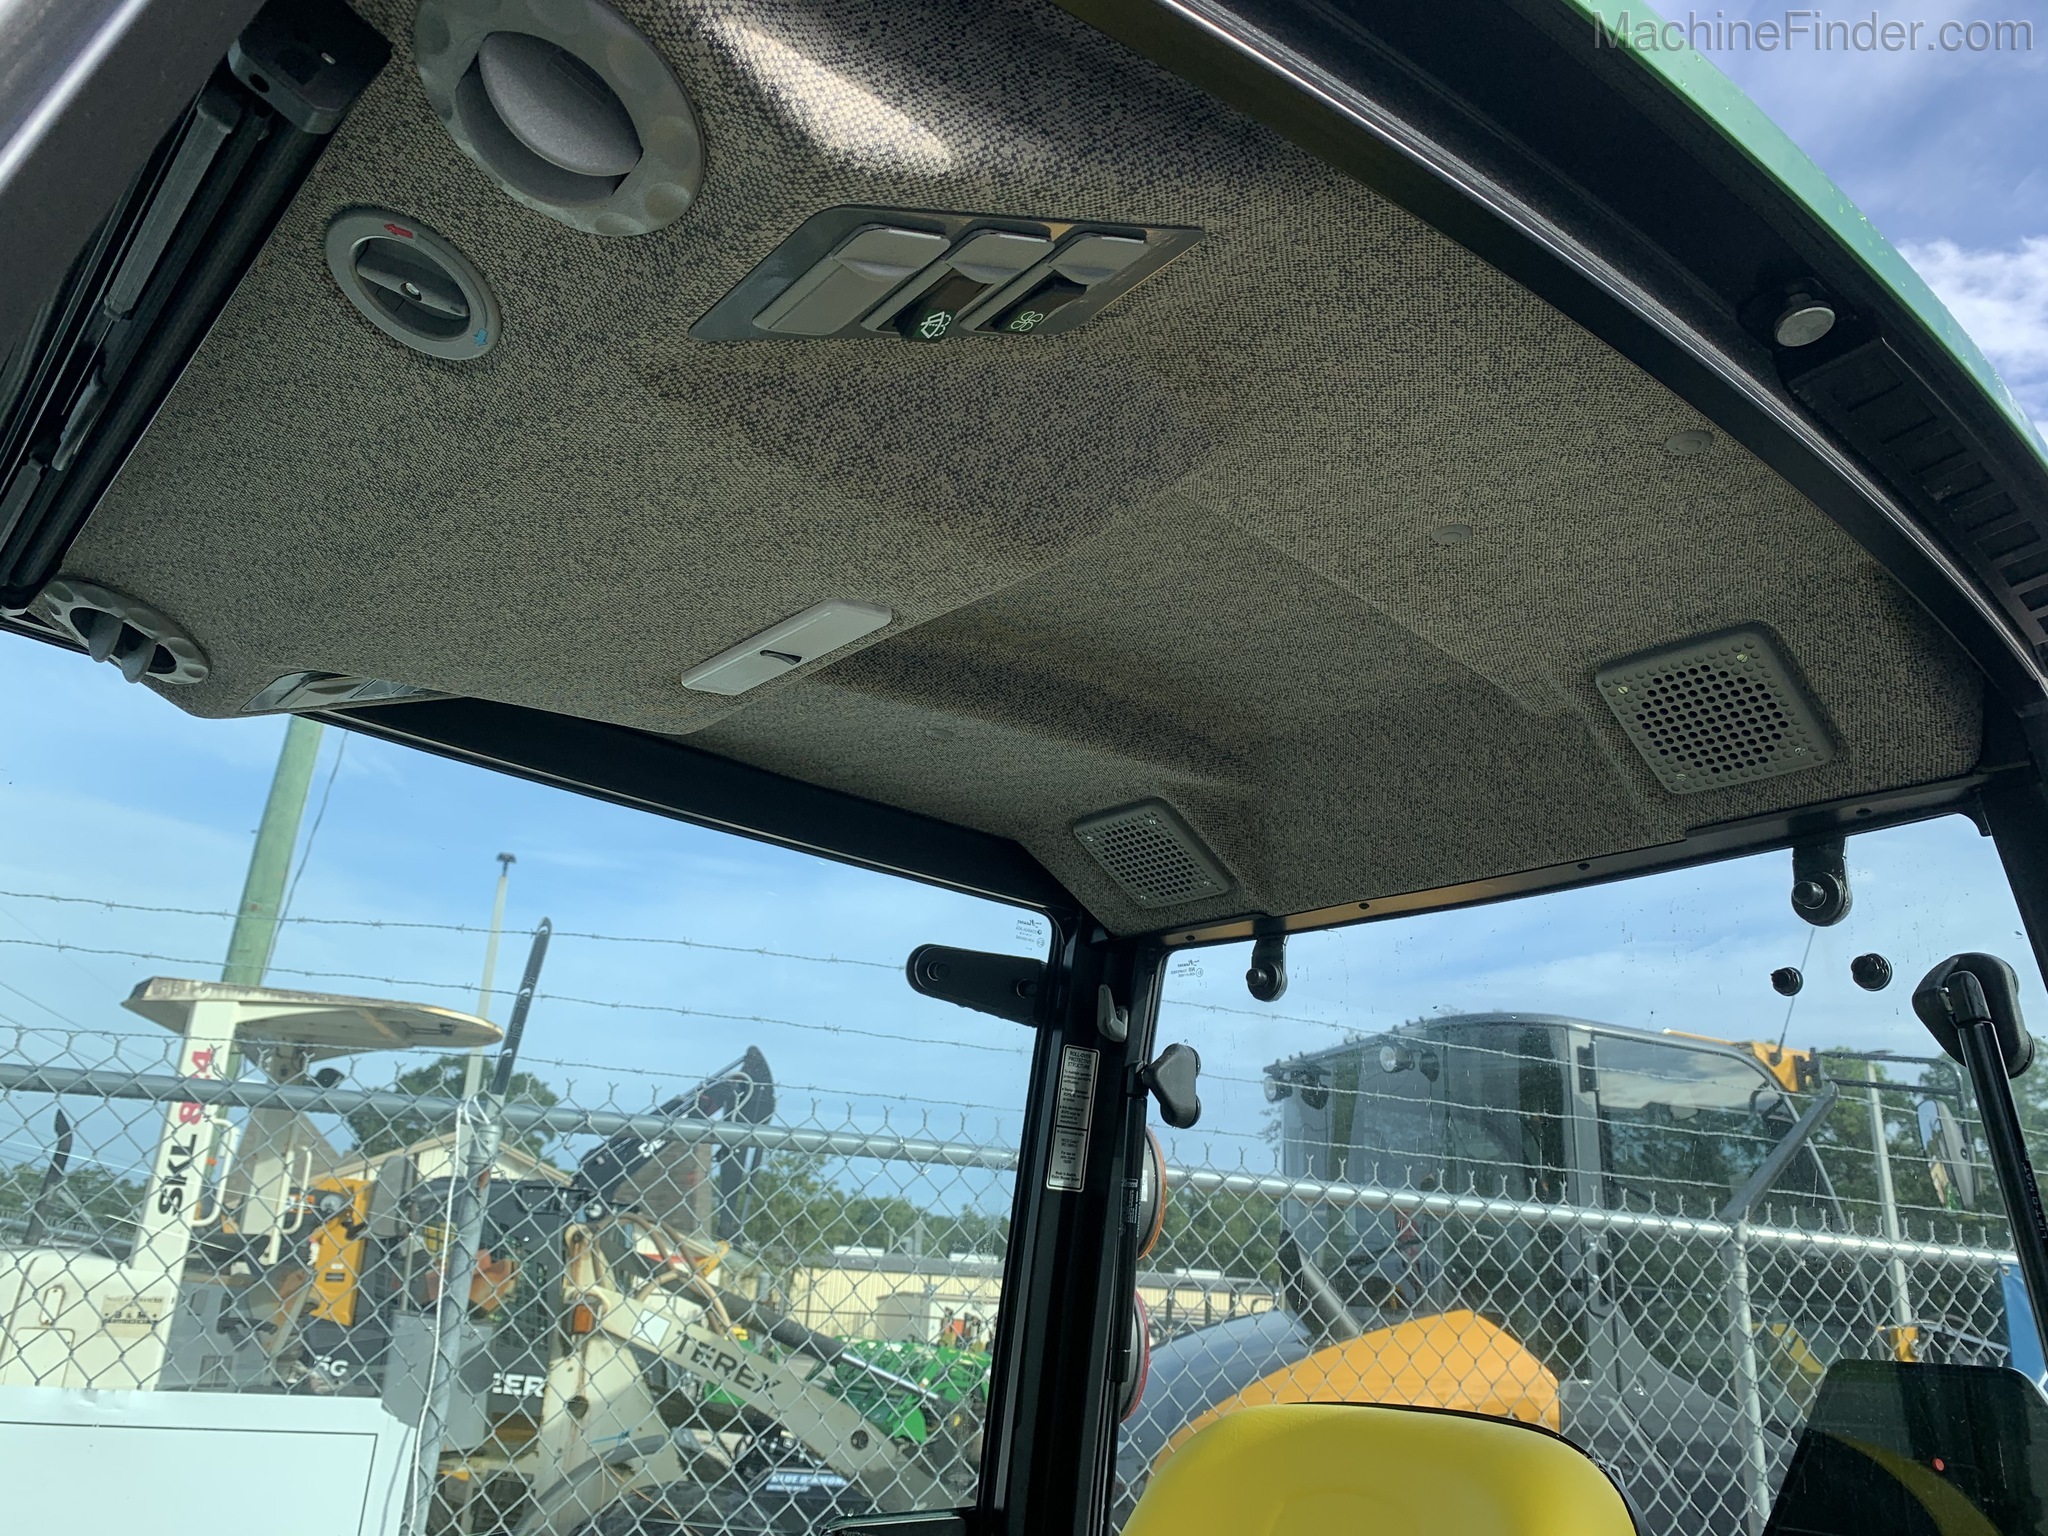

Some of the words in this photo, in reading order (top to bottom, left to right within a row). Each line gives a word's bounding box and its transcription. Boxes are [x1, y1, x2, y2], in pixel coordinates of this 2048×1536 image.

[158, 1134, 197, 1217] SKL
[179, 1048, 213, 1126] 84
[677, 1330, 782, 1400] TEREX
